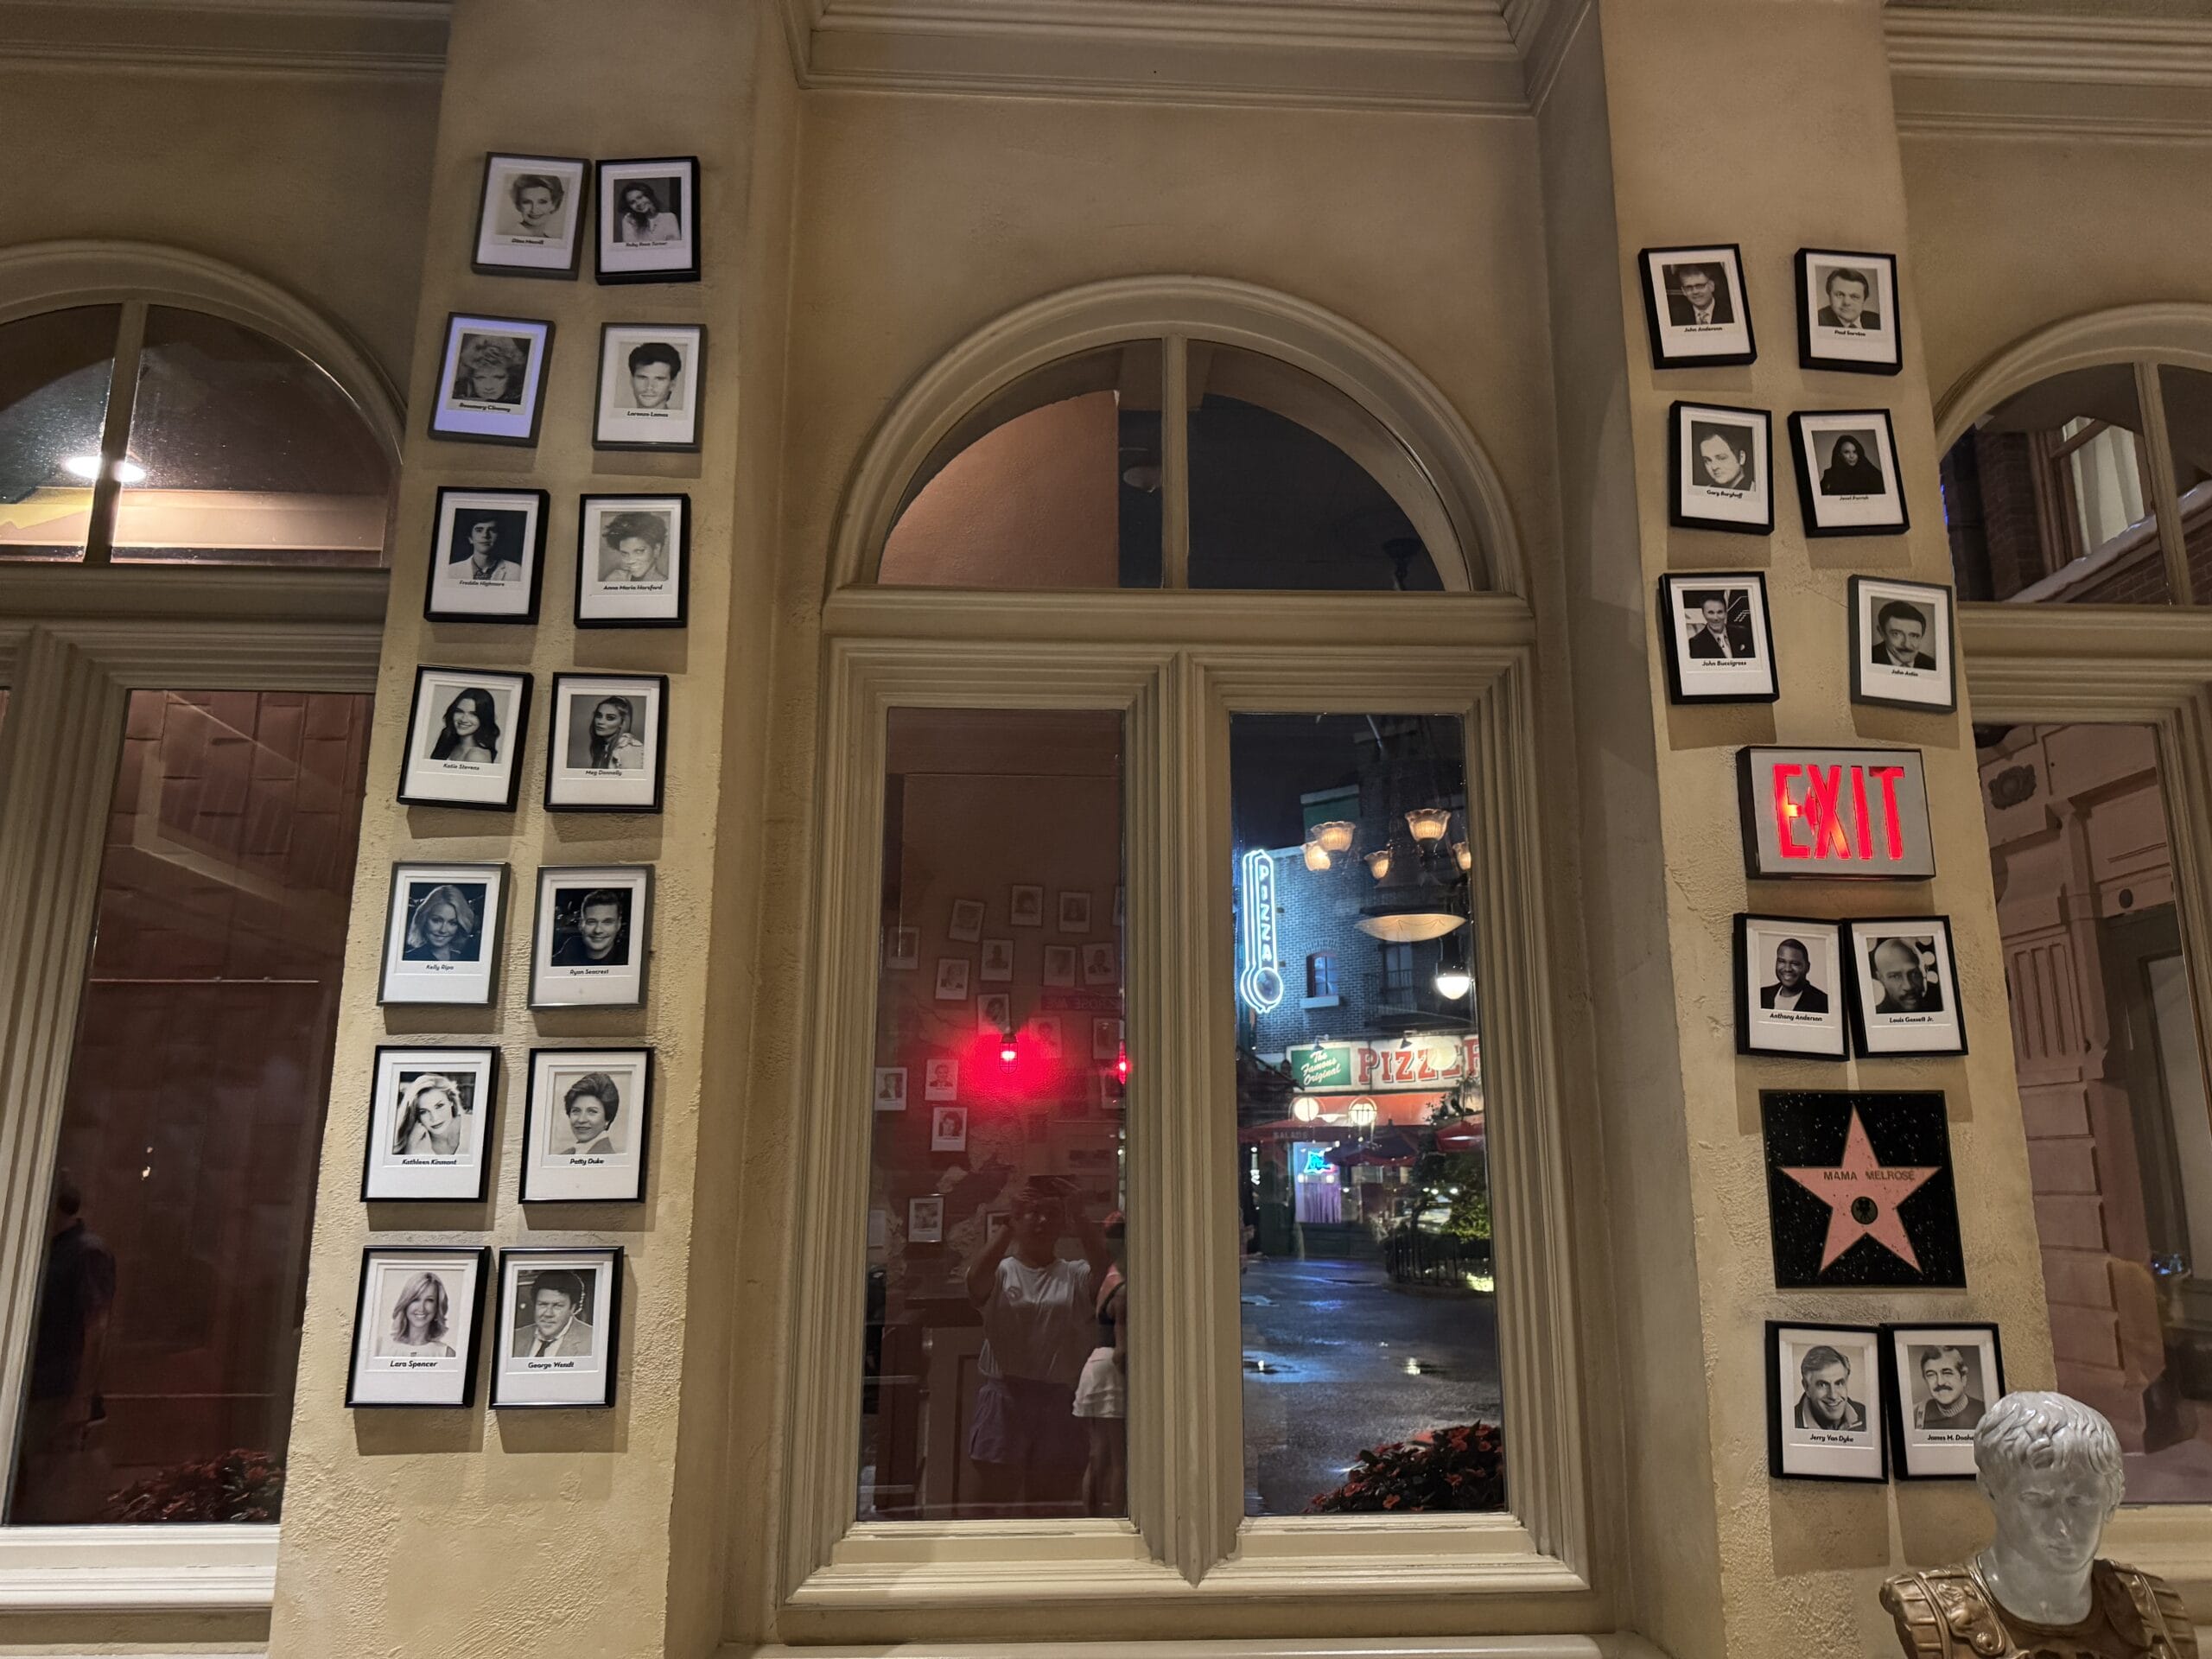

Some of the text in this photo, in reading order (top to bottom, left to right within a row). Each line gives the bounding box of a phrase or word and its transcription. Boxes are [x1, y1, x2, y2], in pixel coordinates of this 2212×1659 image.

[1772, 763, 1905, 860] EXIT
[1258, 864, 1273, 961] PIZZA
[1770, 1013, 1795, 1021] Anthony
[1310, 1049, 1328, 1063] The
[1300, 1058, 1338, 1077] Famous
[1303, 1063, 1342, 1085] Original
[1823, 1171, 1916, 1181] MAMA MELROSE
[408, 1360, 439, 1369] Spencer
[1809, 1433, 1825, 1442] Jerry
